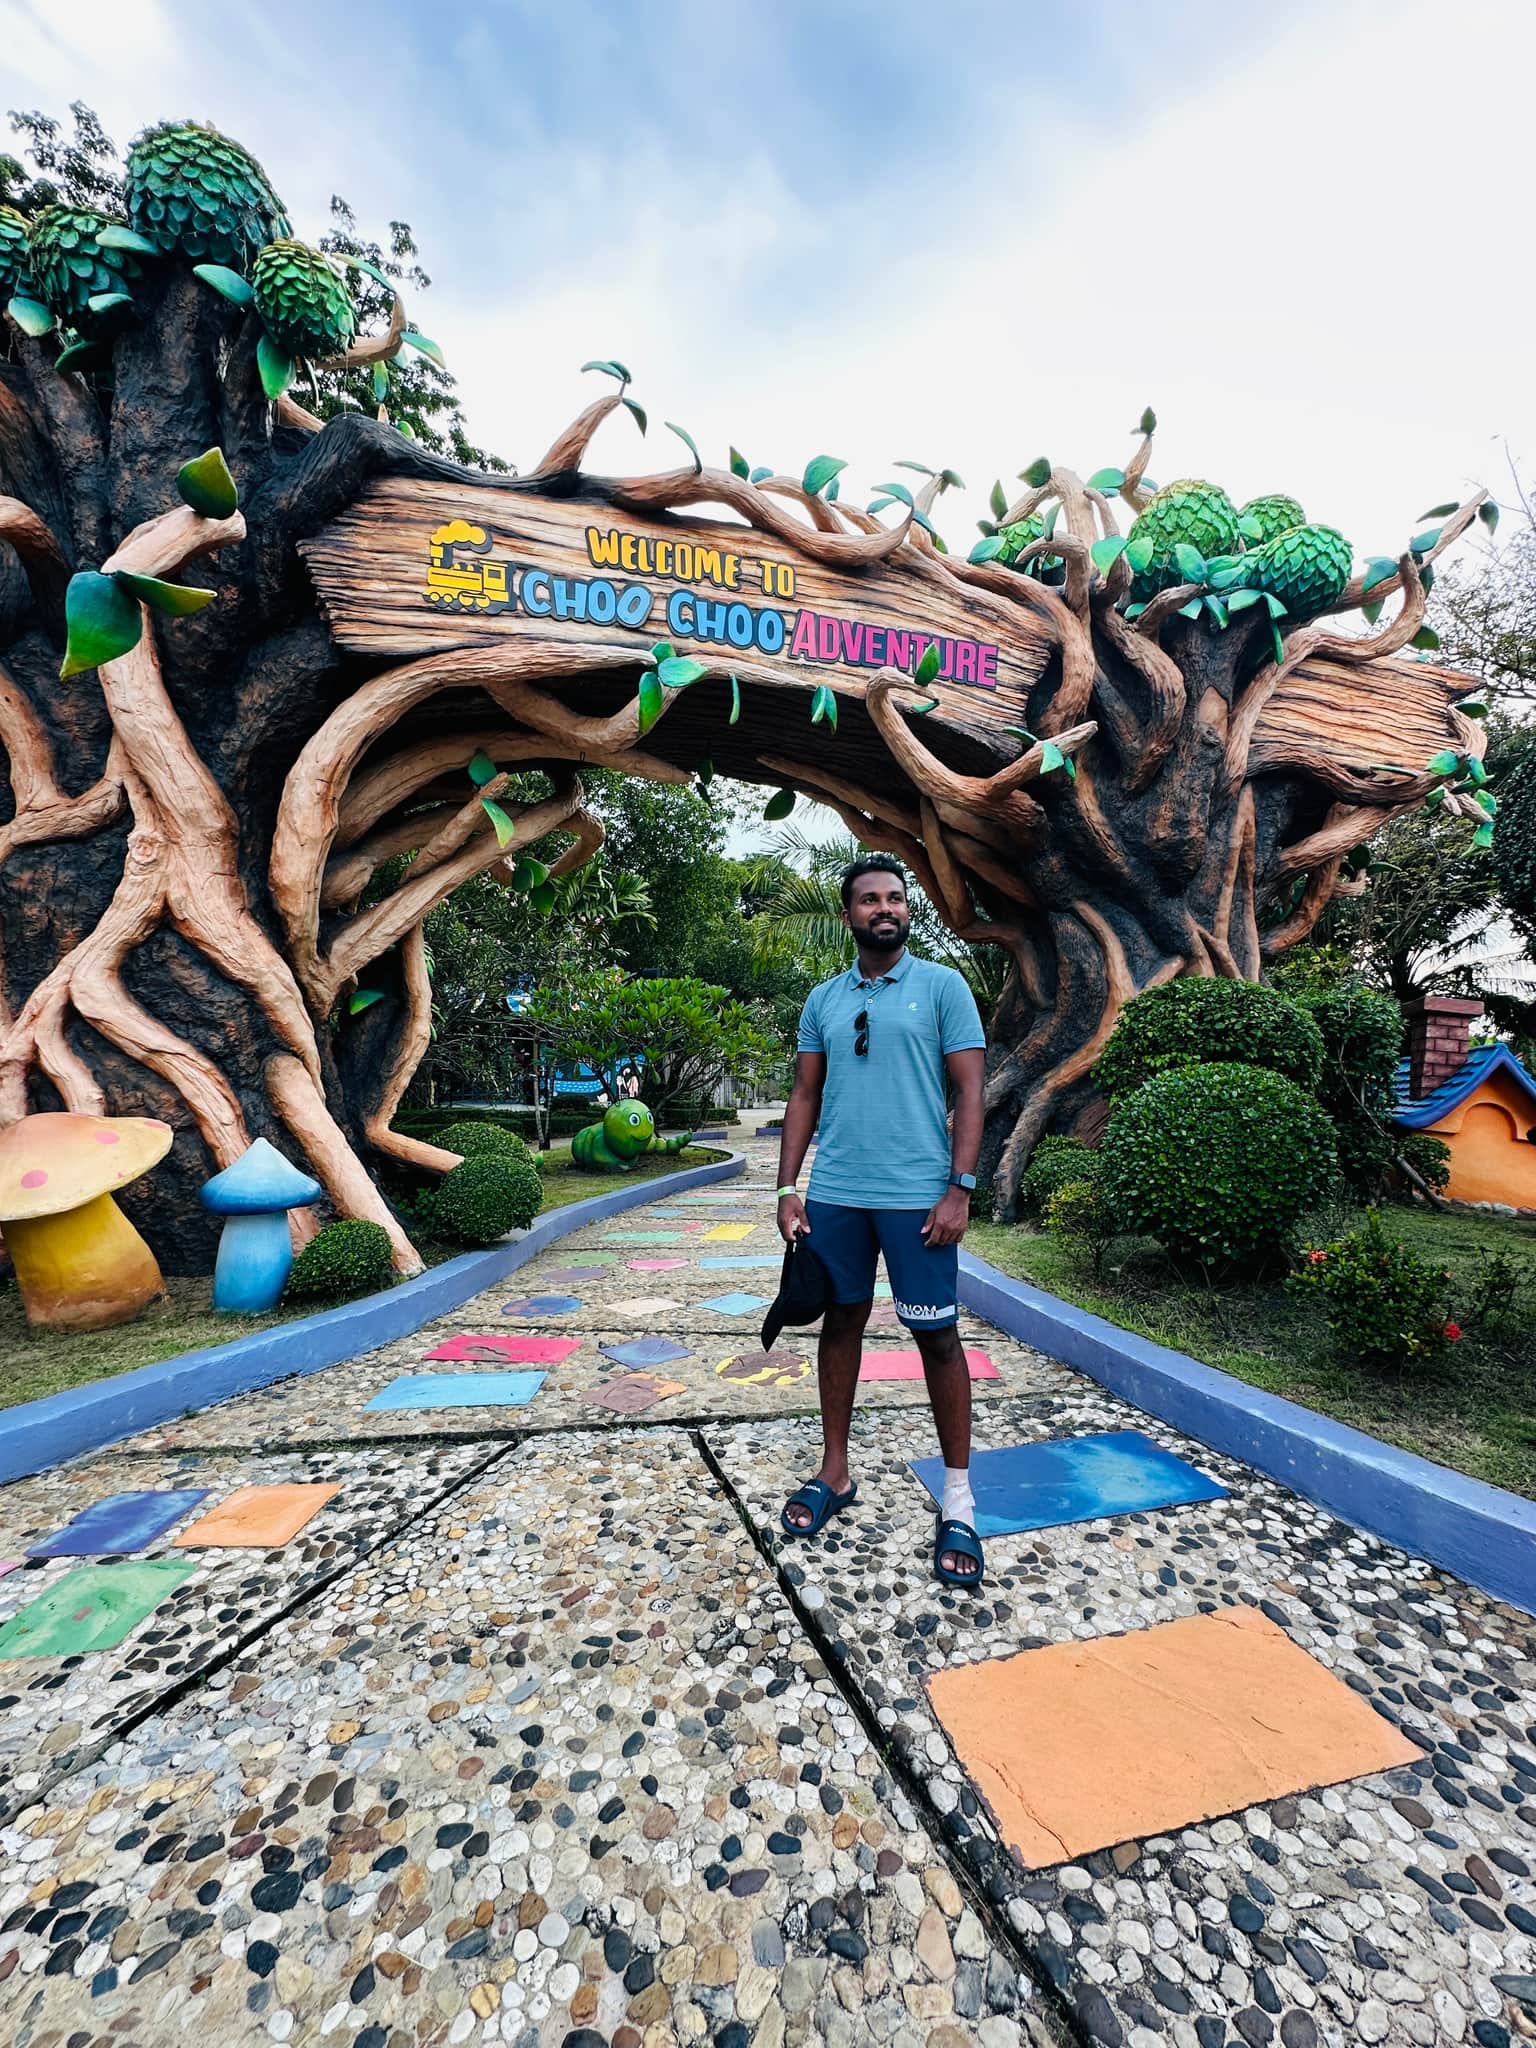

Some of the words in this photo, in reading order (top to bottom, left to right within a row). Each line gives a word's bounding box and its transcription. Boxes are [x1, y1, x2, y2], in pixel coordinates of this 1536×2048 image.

[586, 527, 740, 590] WELCOME
[758, 559, 795, 598] TO
[521, 570, 652, 627] CHOO
[668, 590, 785, 653] CHOO
